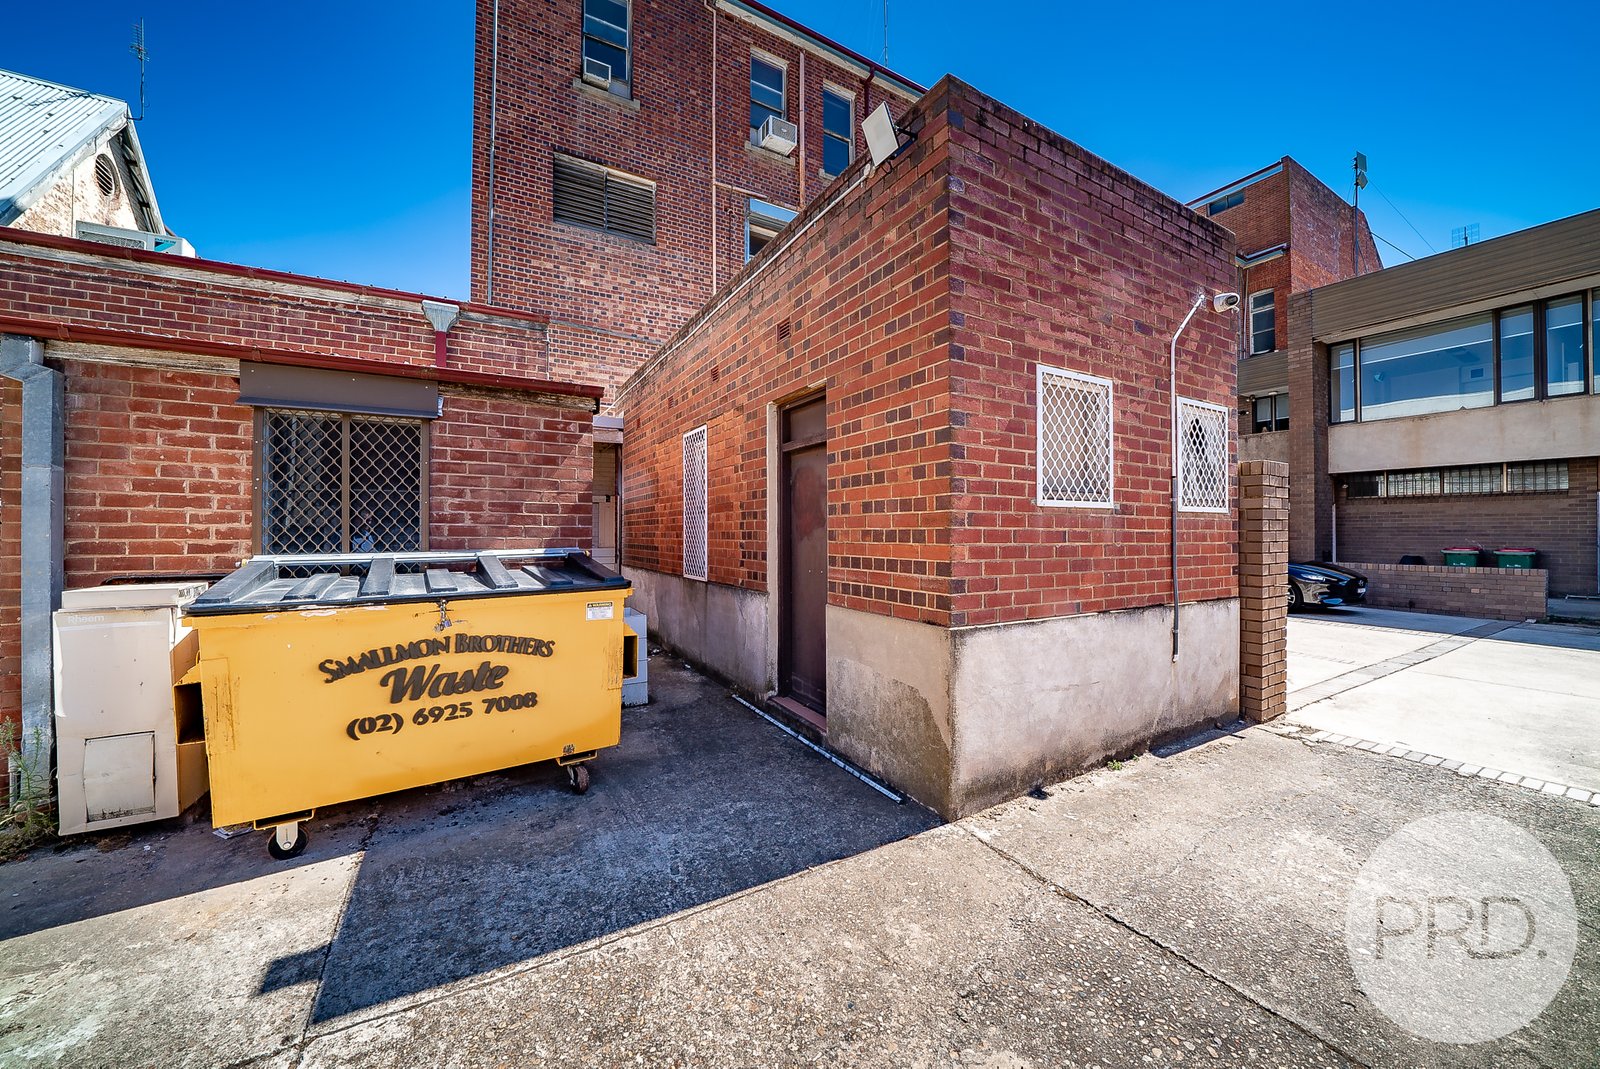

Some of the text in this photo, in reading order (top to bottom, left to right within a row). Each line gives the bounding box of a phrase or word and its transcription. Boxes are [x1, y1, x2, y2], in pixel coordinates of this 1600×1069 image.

[318, 633, 555, 684] SMALLMON BROTHERS
[380, 661, 509, 704] Waste
[346, 691, 538, 741] (02) 6925 7008
